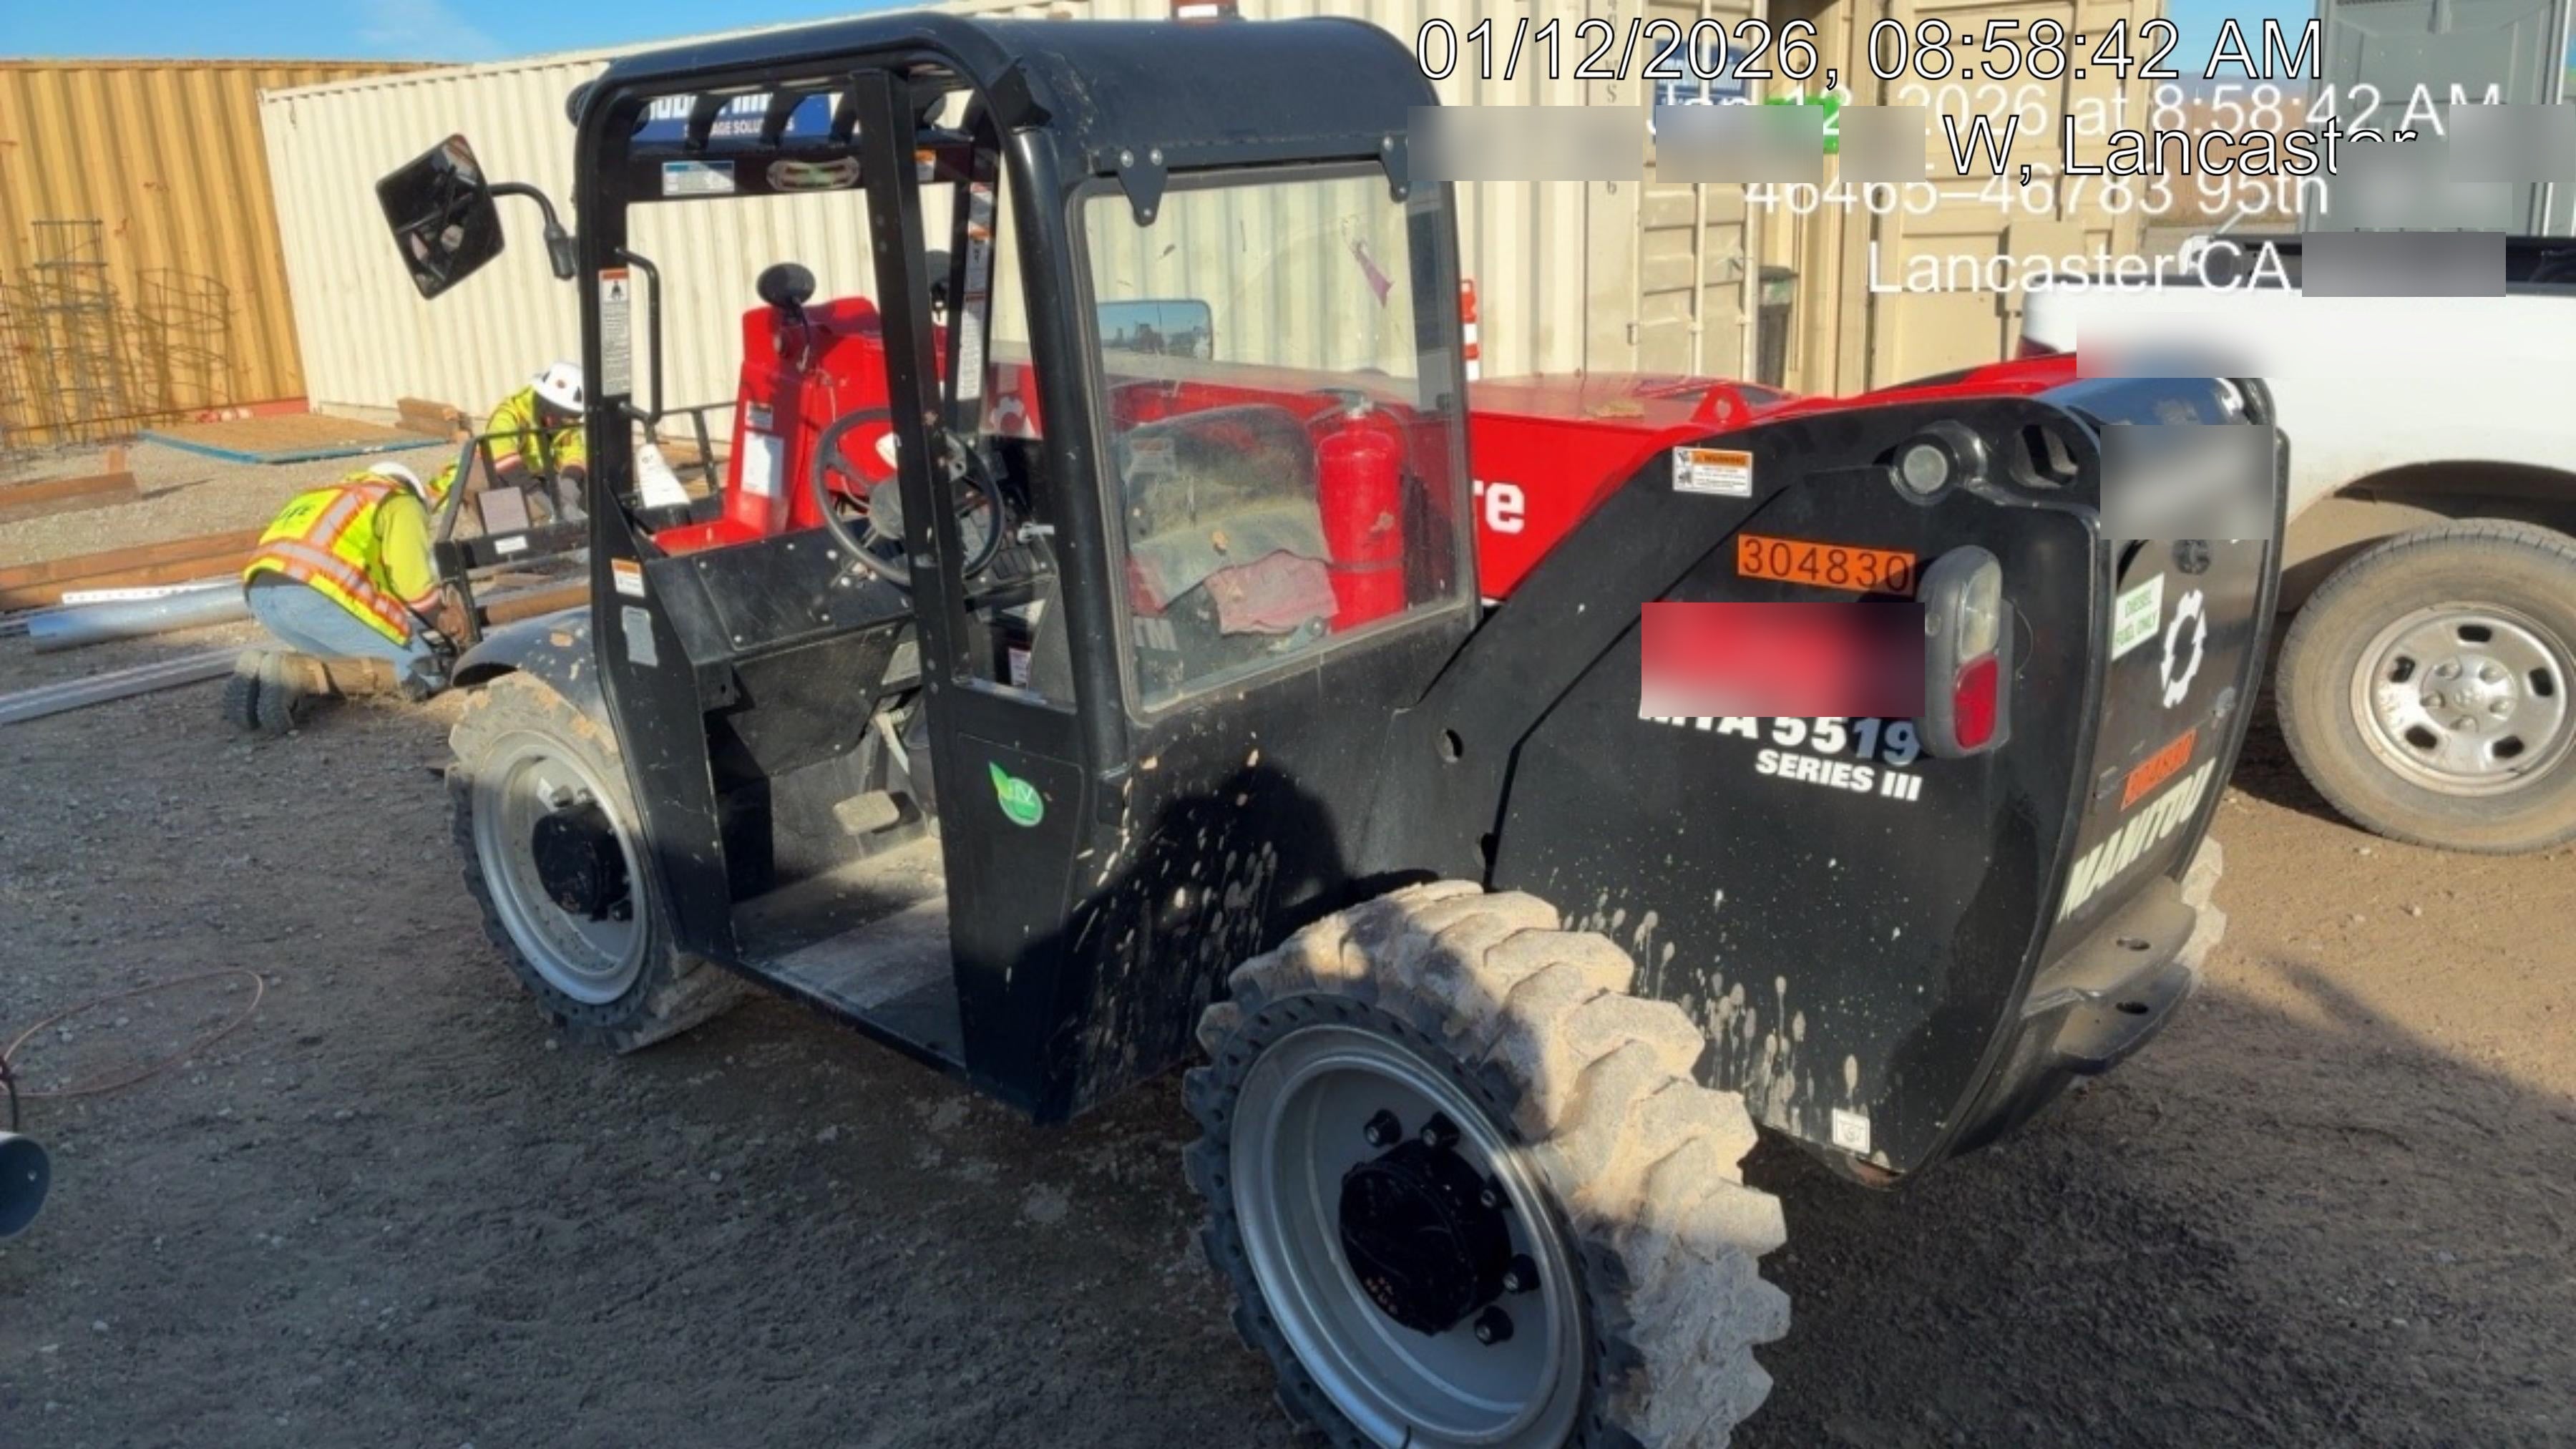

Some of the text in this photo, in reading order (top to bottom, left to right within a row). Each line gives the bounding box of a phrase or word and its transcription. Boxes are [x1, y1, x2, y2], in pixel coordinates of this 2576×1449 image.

[1743, 538, 1909, 592] 304830
[1755, 748, 1923, 802] SERIES III
